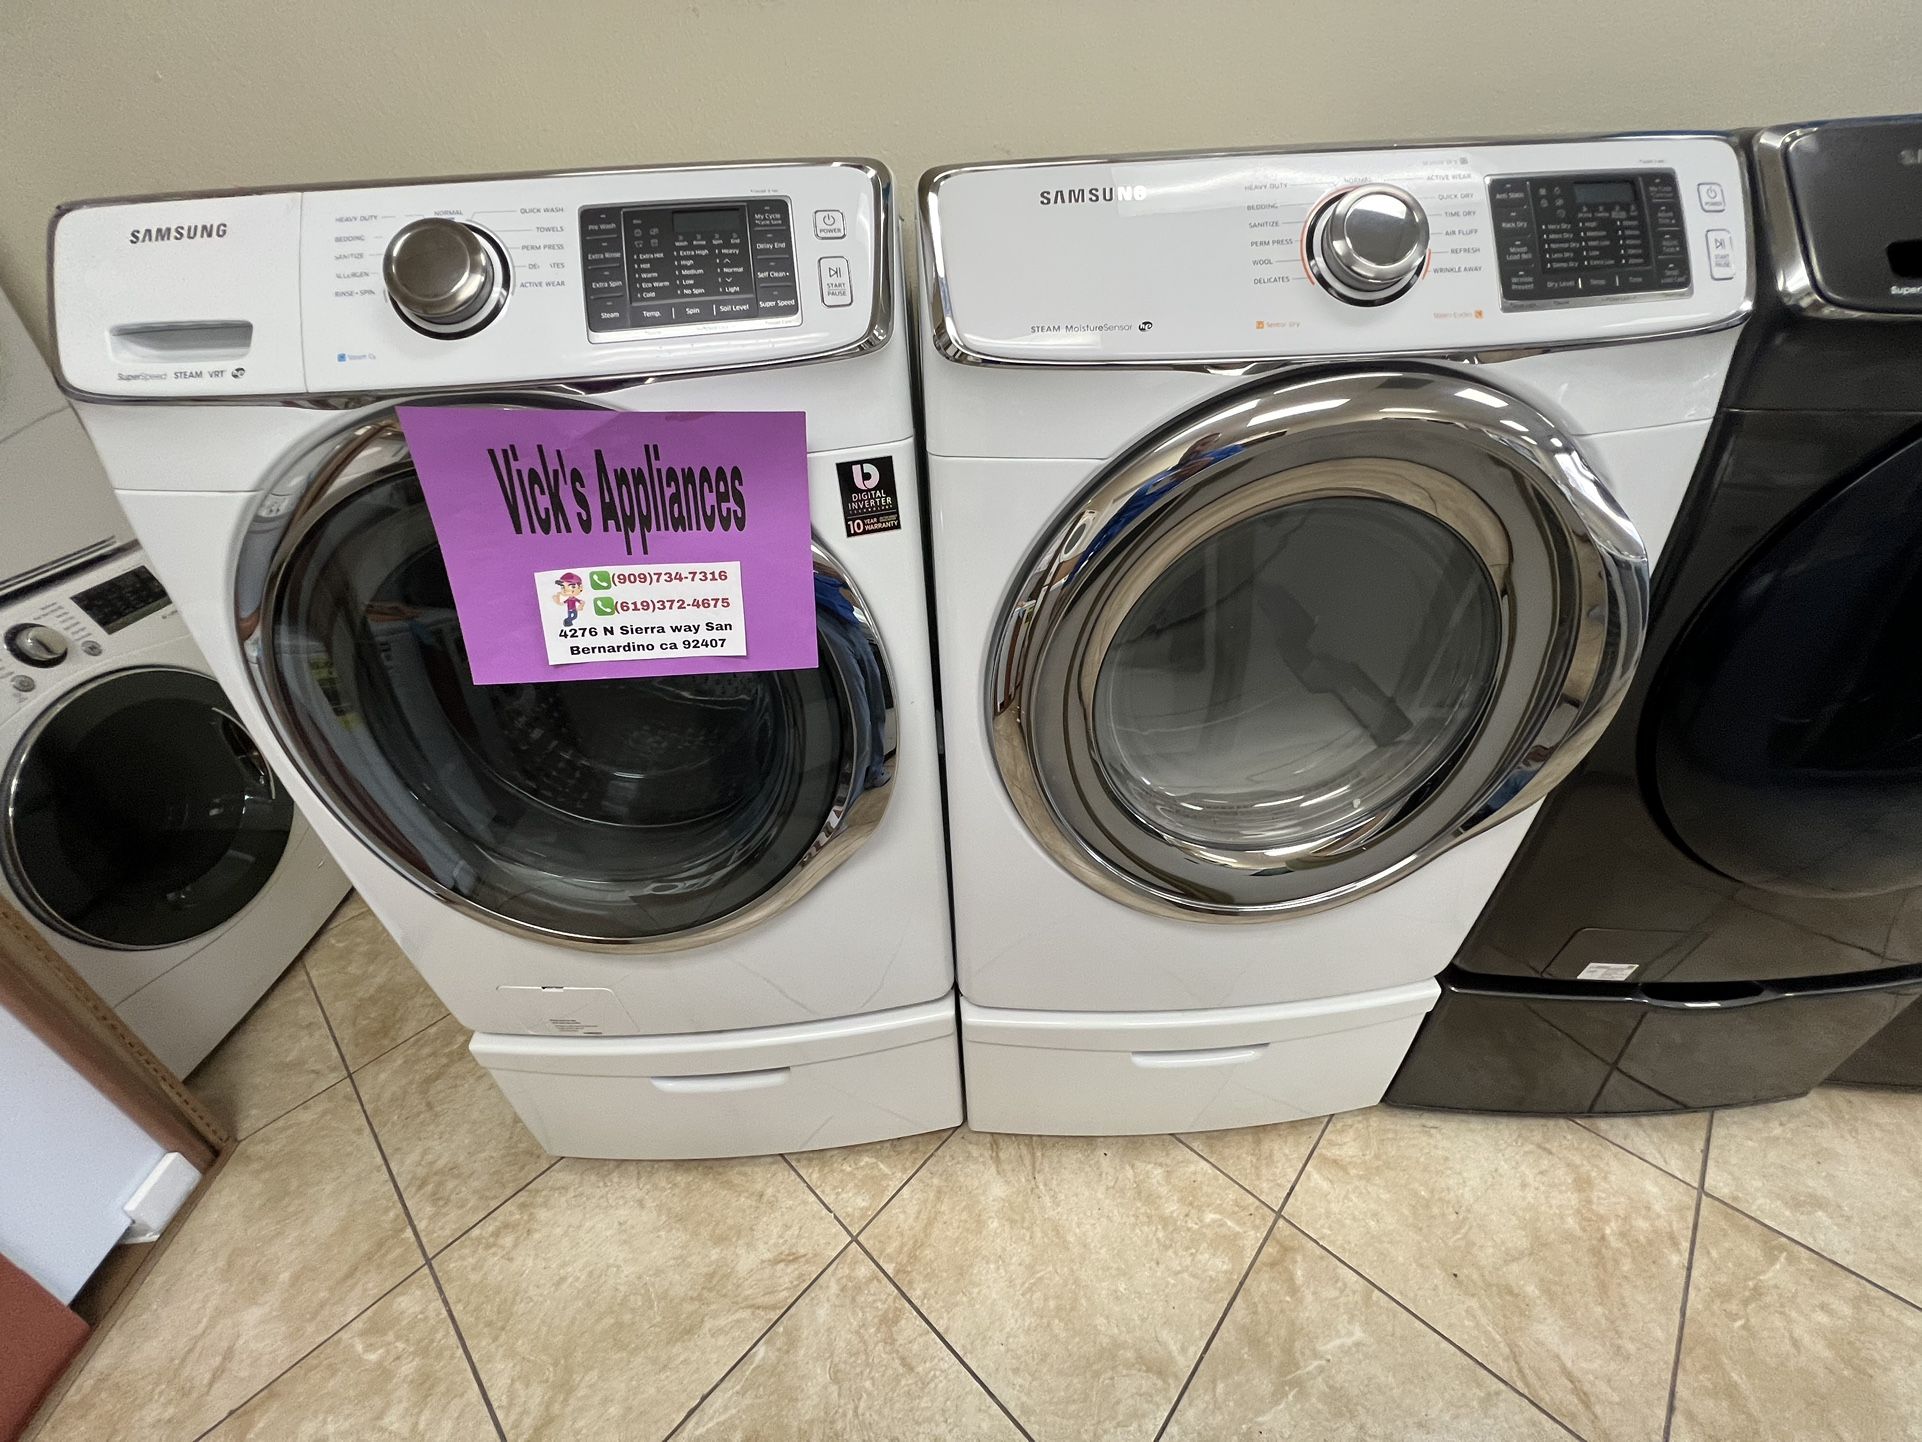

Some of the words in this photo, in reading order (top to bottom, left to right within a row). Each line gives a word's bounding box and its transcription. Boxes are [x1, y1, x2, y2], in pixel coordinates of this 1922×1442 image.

[1269, 182, 1288, 190] DUTY
[1040, 186, 1147, 206] SAMSUNG
[543, 206, 564, 214] WASH
[360, 214, 378, 222] DUTY
[129, 222, 228, 244] SAMSUNG
[1458, 228, 1478, 236] FLUFF
[1272, 238, 1293, 246] PRESS
[528, 262, 565, 270] DETES
[1433, 266, 1462, 274] WRINKLE
[546, 280, 566, 288] WEAR
[609, 280, 623, 288] Spin
[1254, 276, 1290, 284] DELICATES
[759, 300, 776, 308] Super
[778, 299, 796, 307] Speed
[1030, 324, 1060, 333] STEAM
[174, 370, 202, 380] STEAM
[487, 444, 592, 535] Vick's
[594, 444, 747, 556] Appliances
[852, 490, 886, 502] DIGITAL
[848, 496, 892, 510] INVERTER
[848, 520, 864, 534] 10
[864, 520, 898, 531] WARRANTY
[611, 570, 728, 586] (909)734-7316
[614, 596, 730, 614] (619)372-4675
[558, 626, 598, 640] 4276
[604, 625, 614, 636] N
[618, 623, 668, 636] Sierra
[670, 624, 702, 636] way
[705, 620, 733, 632] San
[570, 641, 656, 656] Bernardino
[659, 642, 678, 652] ca
[682, 638, 726, 650] 92407
